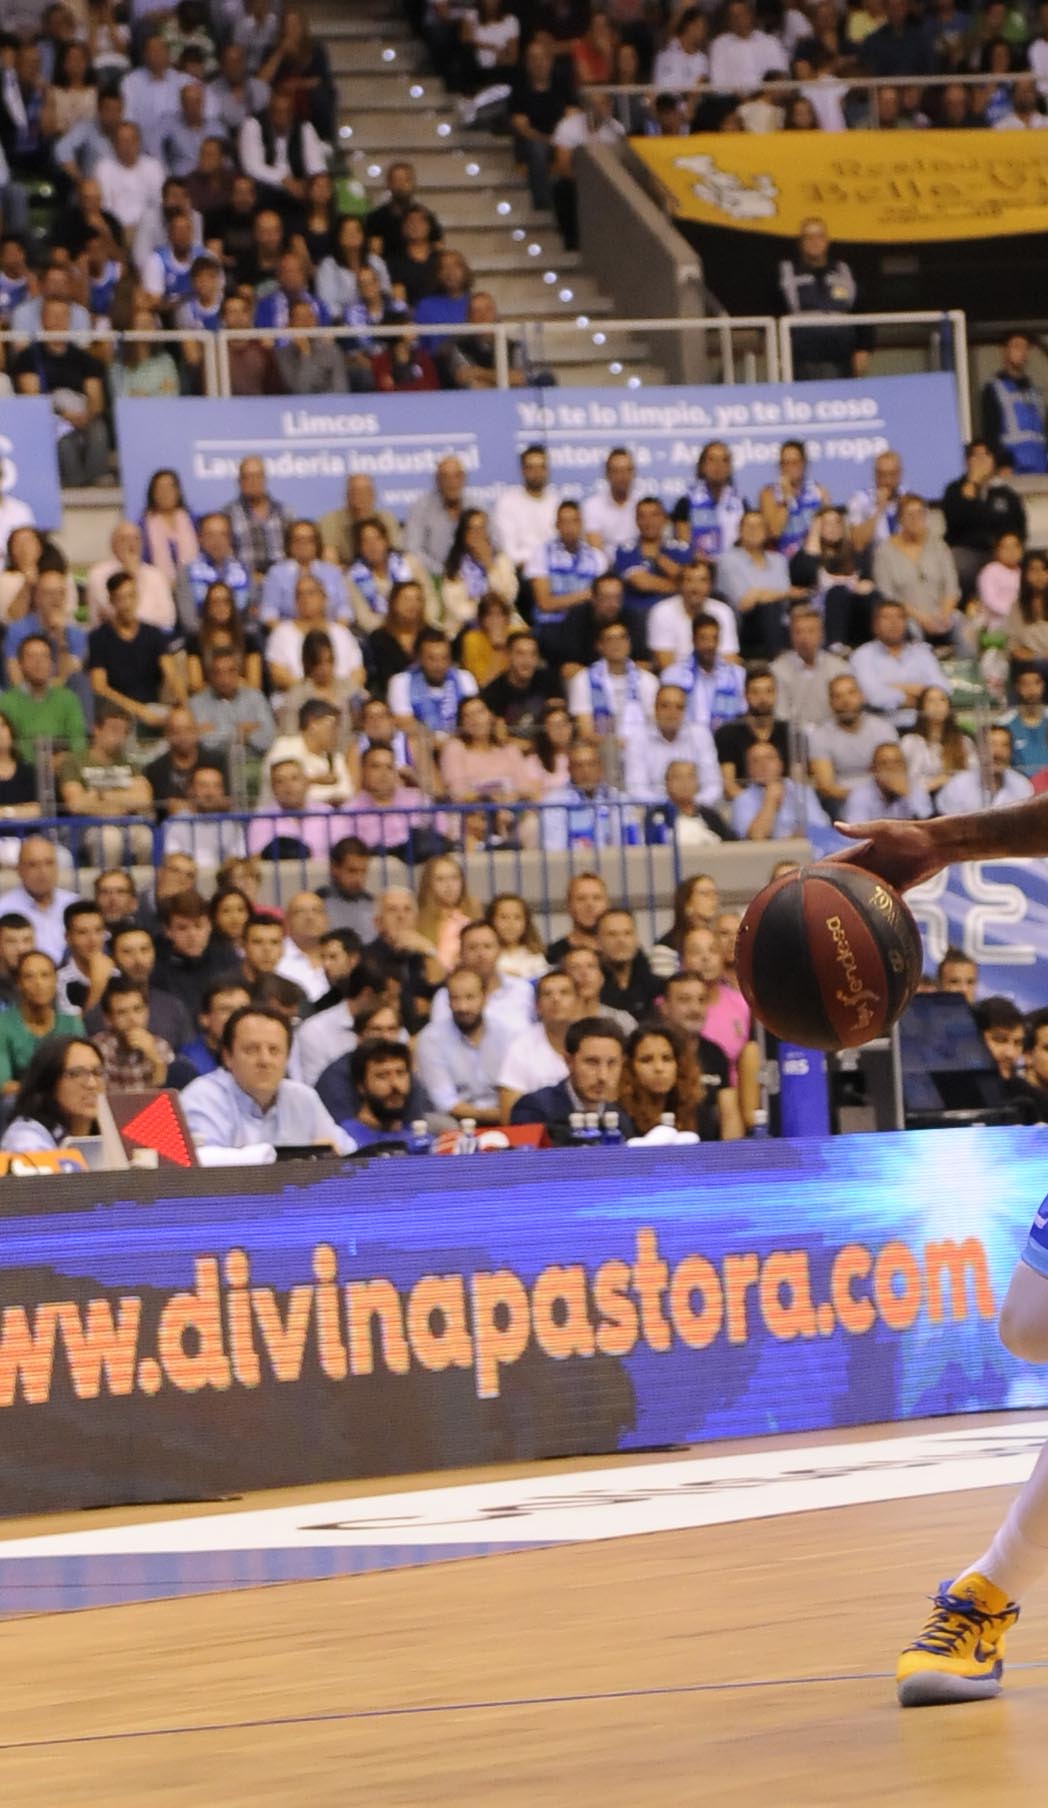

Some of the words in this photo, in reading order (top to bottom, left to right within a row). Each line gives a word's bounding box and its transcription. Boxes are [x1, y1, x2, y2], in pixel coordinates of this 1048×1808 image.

[282, 409, 381, 437] Limcos
[557, 402, 586, 425] te
[588, 399, 618, 425] lo
[714, 404, 749, 432] yo
[752, 400, 781, 423] te
[782, 396, 813, 422] lo
